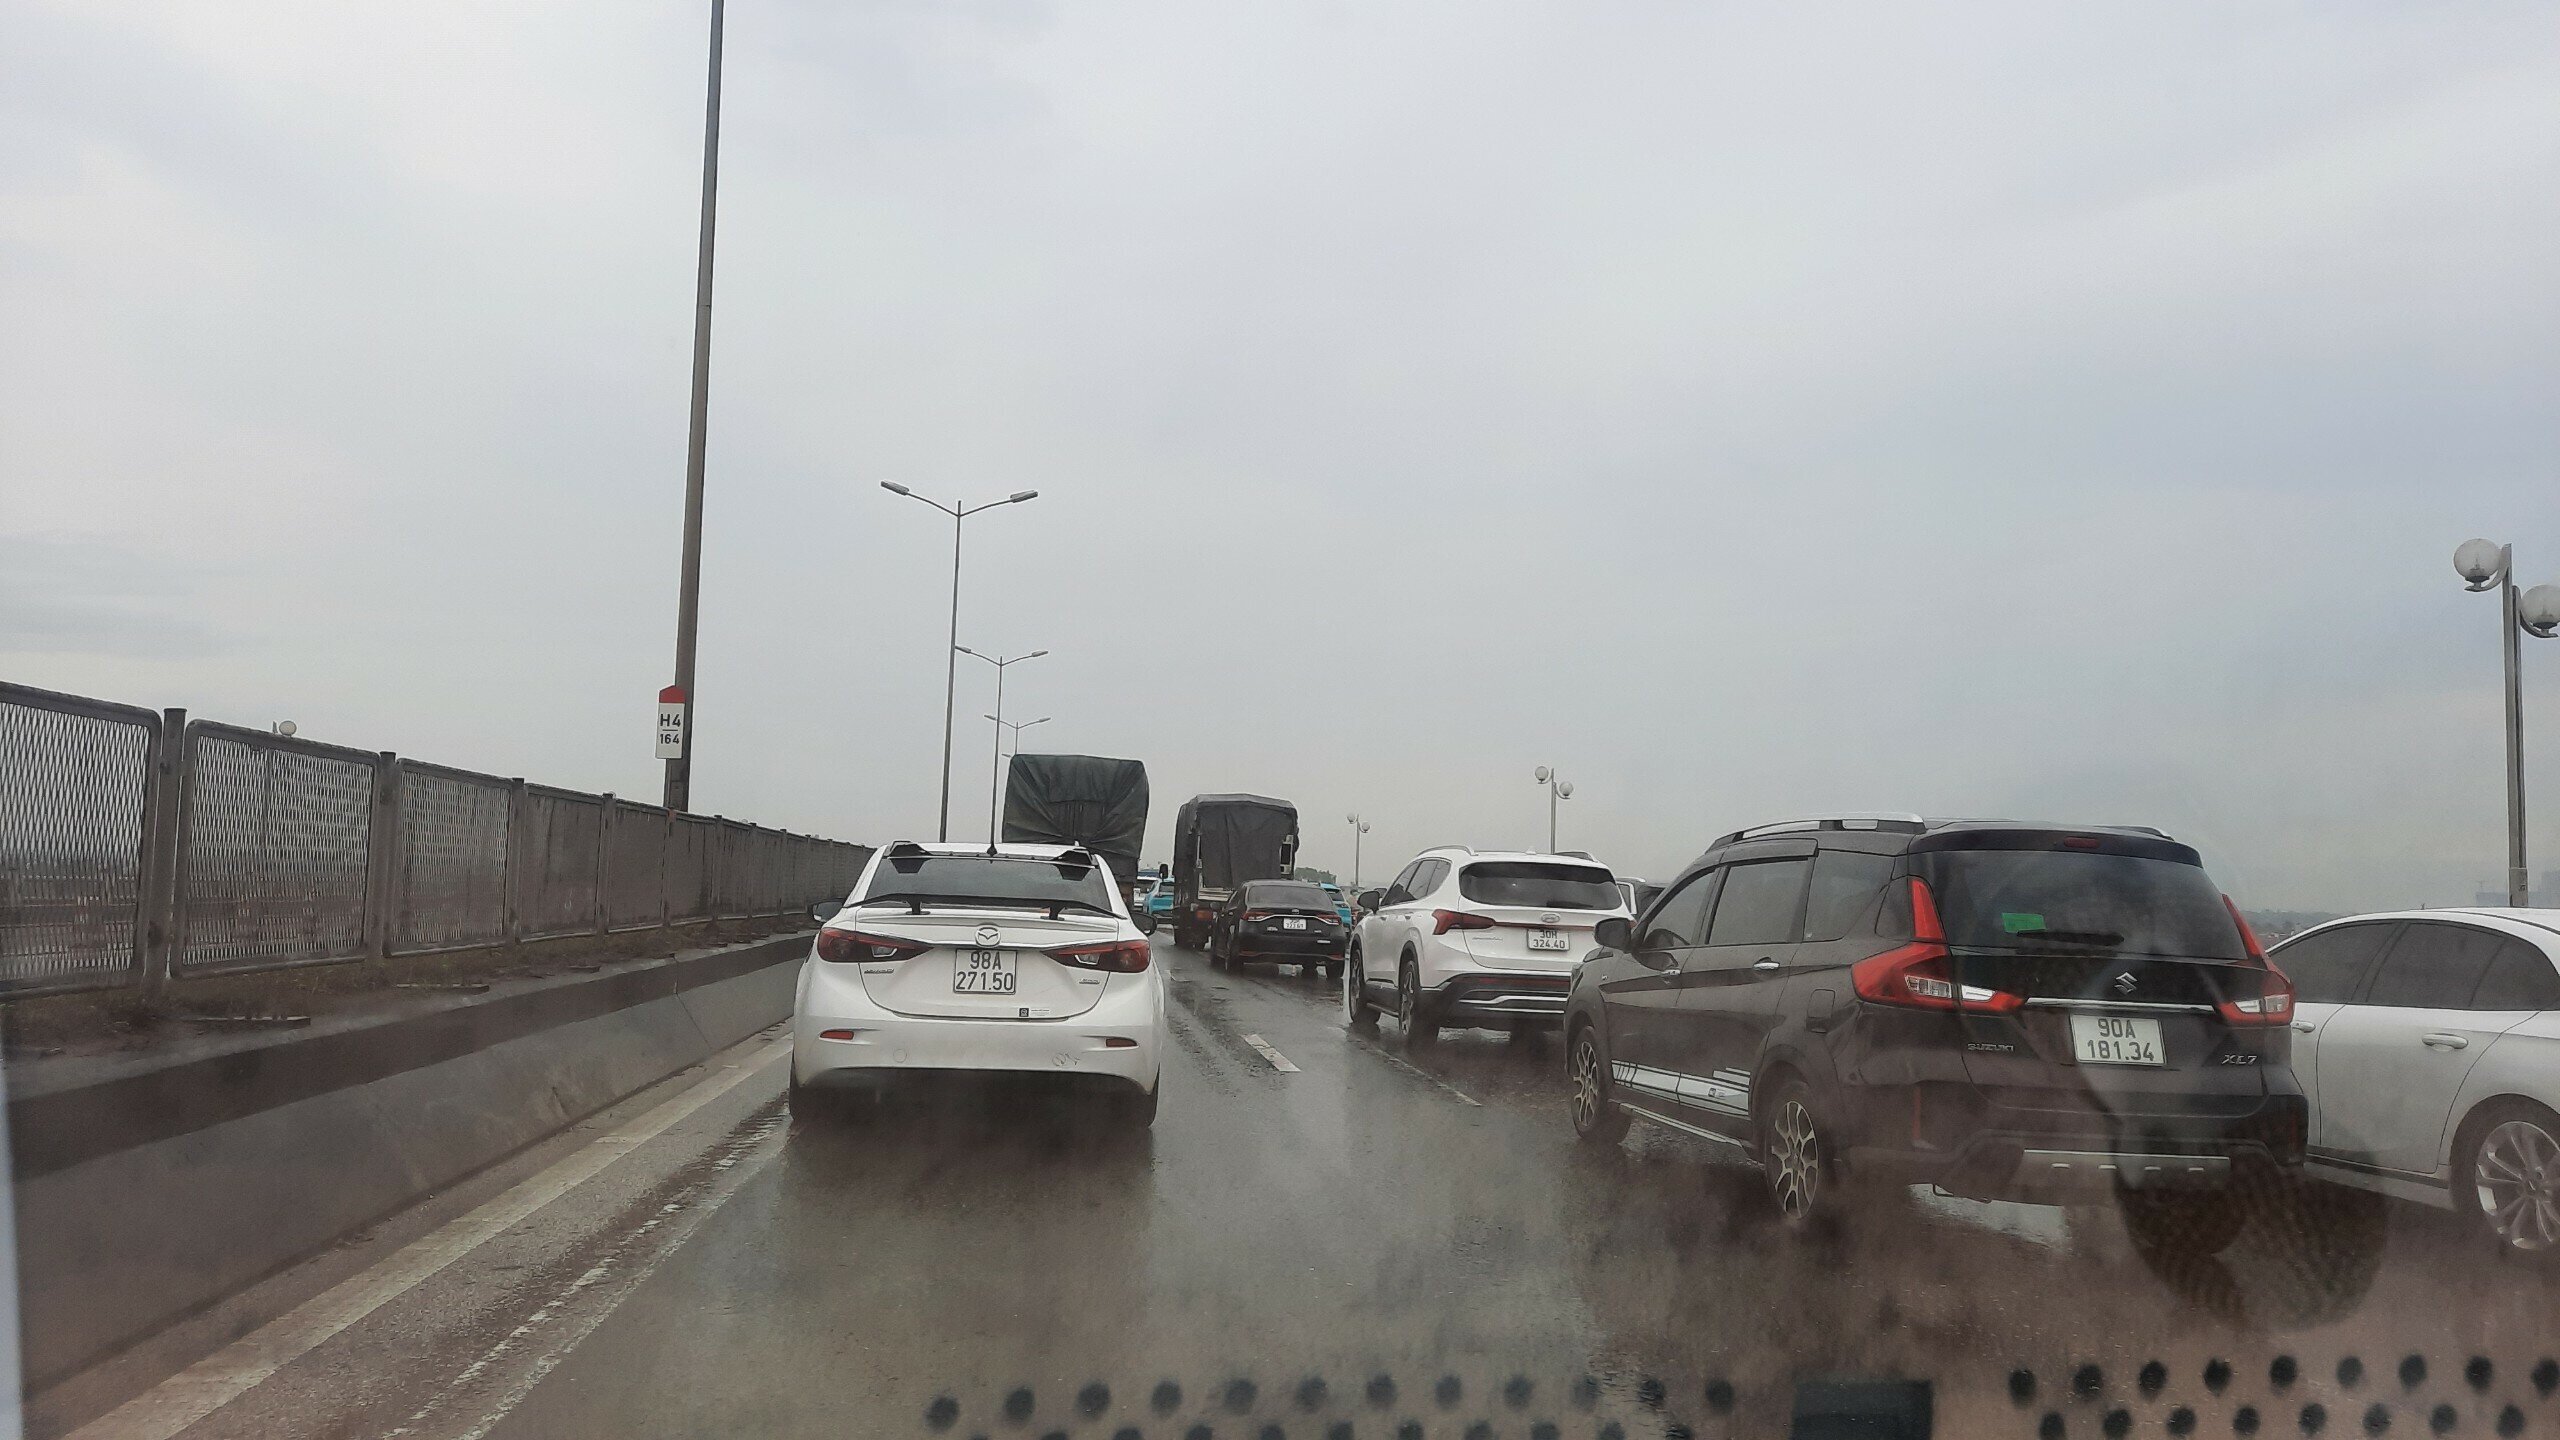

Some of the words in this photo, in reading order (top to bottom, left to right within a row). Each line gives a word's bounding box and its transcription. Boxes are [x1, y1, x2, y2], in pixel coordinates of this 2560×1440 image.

[660, 713, 681, 727] H4
[660, 733, 680, 745] 164
[1533, 939, 1566, 949] 324.40
[970, 951, 1002, 970] 98A
[956, 971, 1014, 991] 271.50
[2098, 1018, 2136, 1039] 90A
[2087, 1040, 2155, 1061] 181.34
[2221, 1054, 2258, 1066] XL7
